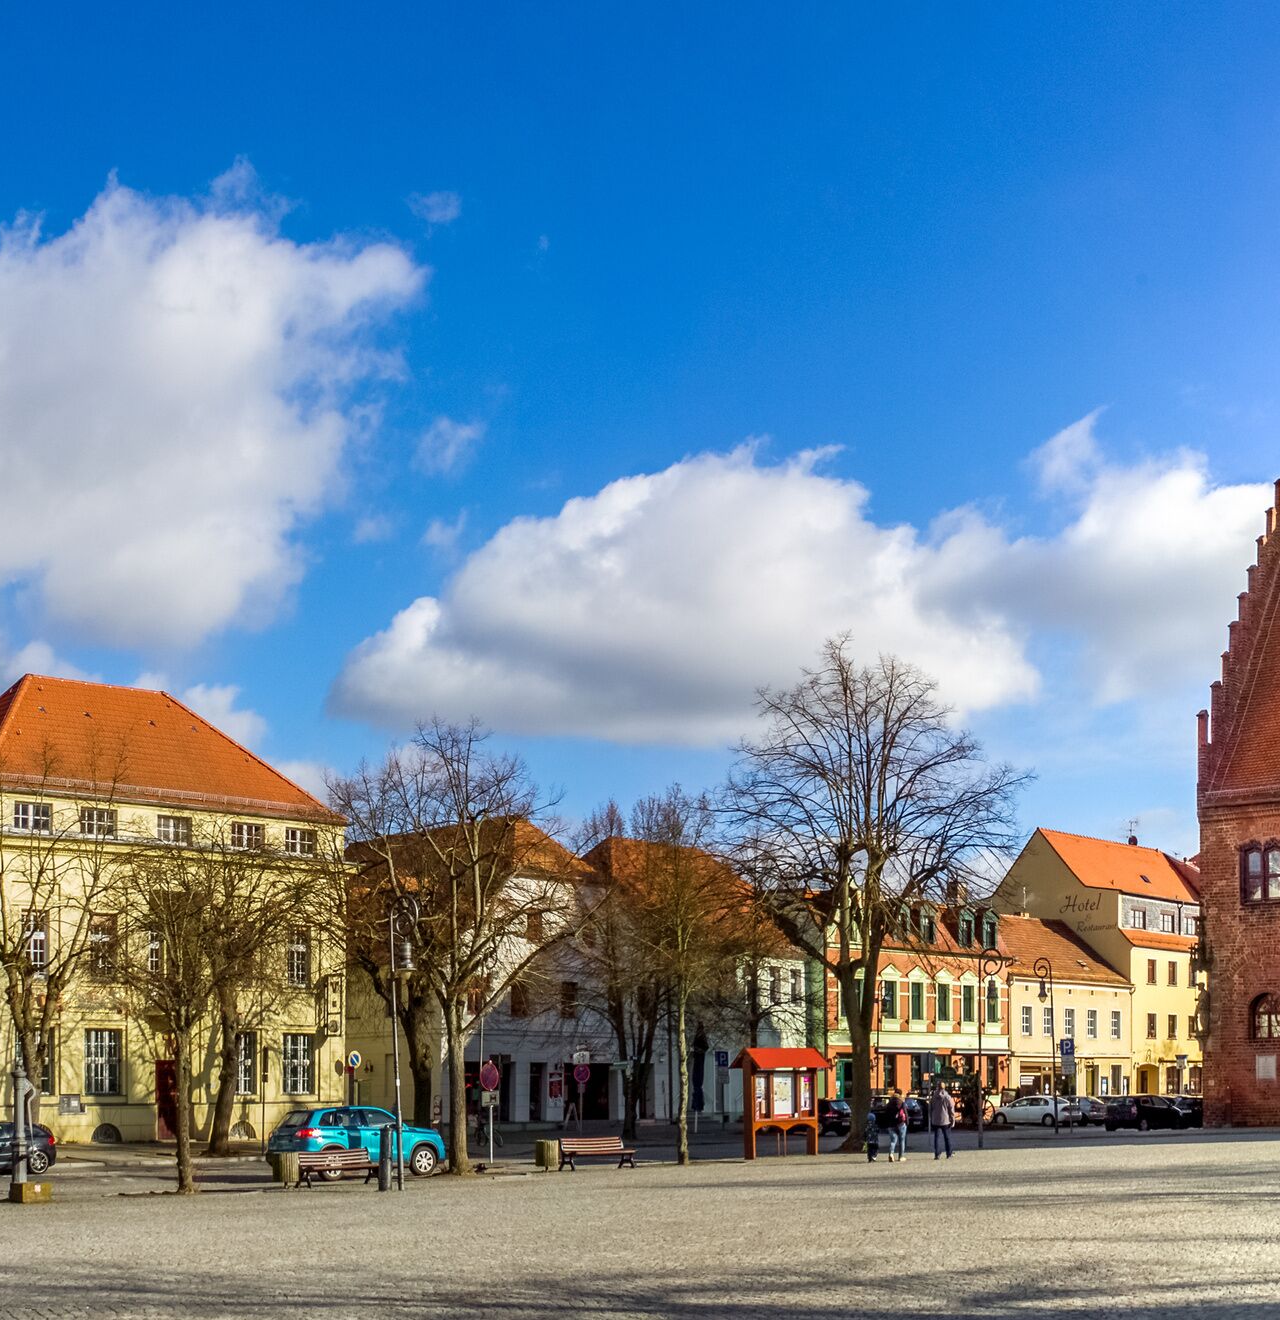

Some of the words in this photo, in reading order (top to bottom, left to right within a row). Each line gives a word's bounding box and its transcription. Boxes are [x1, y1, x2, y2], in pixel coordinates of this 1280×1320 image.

[1059, 892, 1102, 914] Hotel
[1076, 921, 1118, 932] Restaurant
[1063, 1040, 1071, 1054] P
[719, 1053, 726, 1064] P
